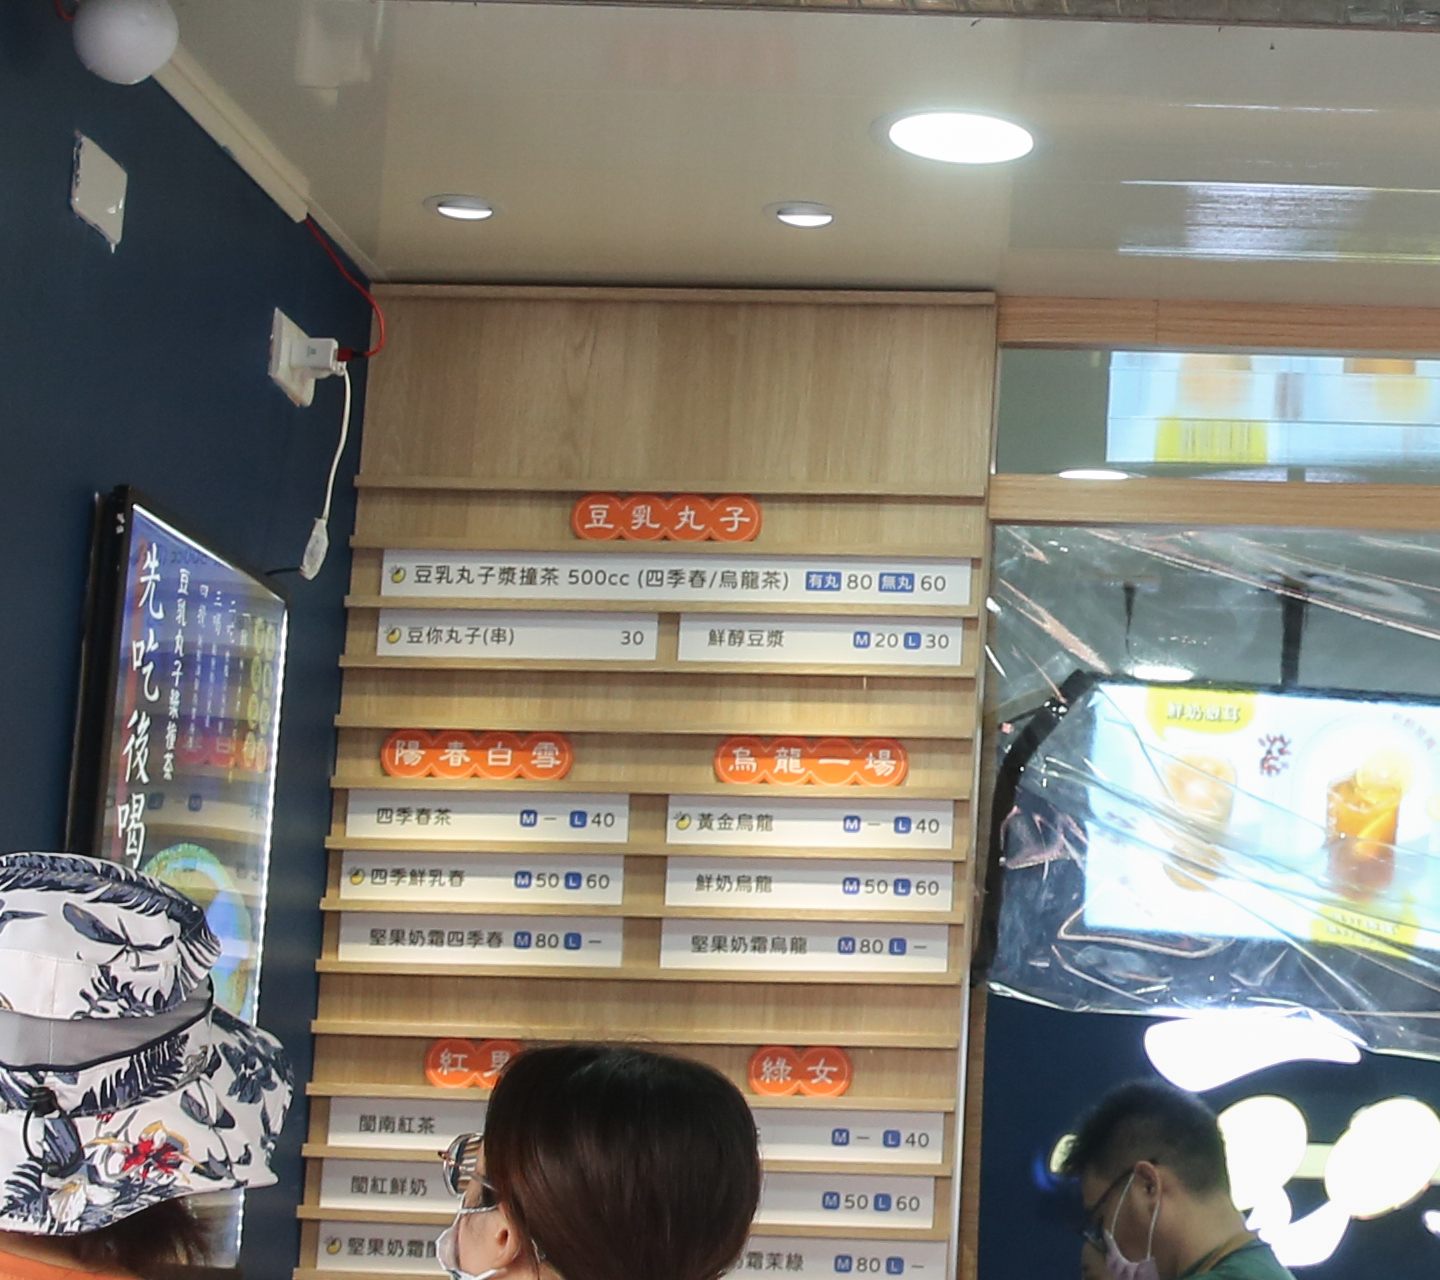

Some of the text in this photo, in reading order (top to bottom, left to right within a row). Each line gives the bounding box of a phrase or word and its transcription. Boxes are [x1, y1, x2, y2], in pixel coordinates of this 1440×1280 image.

[584, 504, 751, 533] 豆乳丸子
[413, 565, 947, 592] 豆乳丸子漿撞茶 500cc (四季春/烏龍茶) 有丸 80 無丸 60
[406, 627, 645, 646] 豆你丸子(串) 30
[707, 629, 785, 648] 鮮醇豆漿
[875, 633, 899, 648] 20
[925, 634, 950, 649] 30
[117, 543, 164, 870] 先吃後喝
[394, 740, 562, 768] 陽春白雪
[729, 747, 898, 777] 烏龍一場
[376, 807, 452, 826] 四季春茶
[591, 812, 616, 828] 40
[696, 813, 774, 832] 黃金烏龍
[915, 818, 940, 834] 40
[370, 868, 465, 887] 四季鮮乳春
[535, 874, 560, 889] 50
[586, 874, 610, 889] 60
[695, 874, 773, 894] 鮮奶烏龍
[864, 879, 888, 895] 50
[915, 880, 940, 896] 60
[369, 928, 503, 948] 堅果奶霜四季春
[535, 934, 560, 949] 80
[691, 935, 808, 955] 堅果奶霜烏龍
[859, 938, 884, 954] 80
[760, 1056, 839, 1085] 綠女
[358, 1114, 435, 1134] 閩南紅茶
[905, 1132, 930, 1148] 40
[350, 1176, 427, 1196] 閩紅鮮奶
[844, 1194, 868, 1210] 50
[896, 1196, 921, 1212] 60
[856, 1257, 881, 1273] 80
